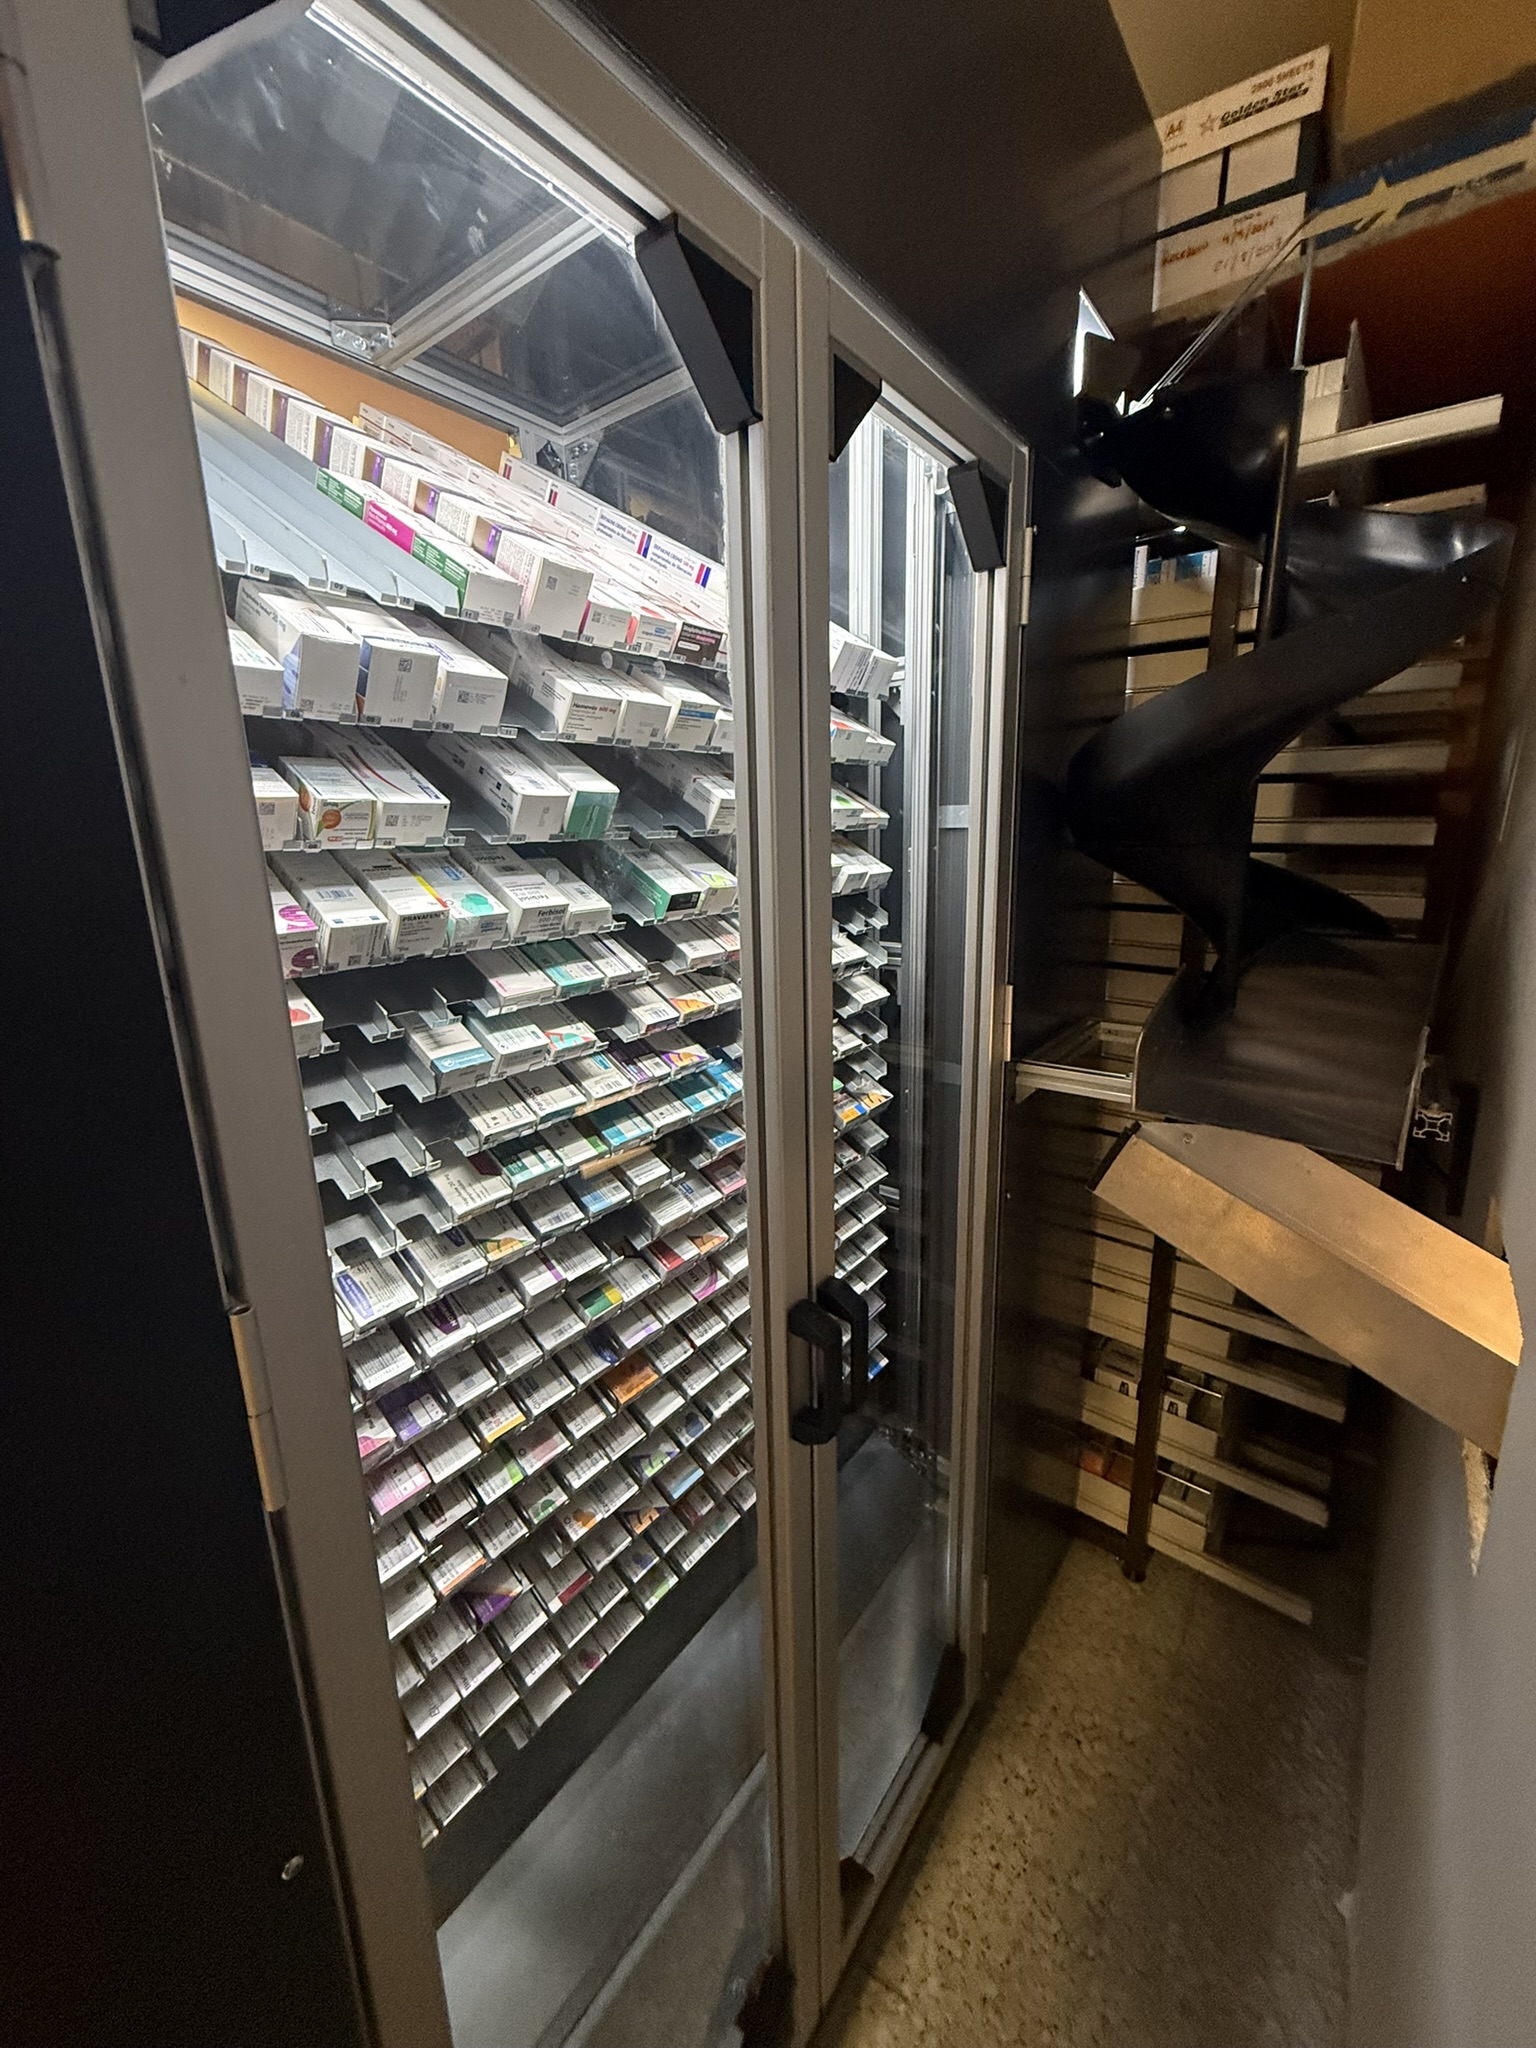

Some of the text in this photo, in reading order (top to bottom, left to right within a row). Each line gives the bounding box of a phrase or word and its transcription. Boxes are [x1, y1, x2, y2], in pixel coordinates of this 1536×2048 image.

[1277, 60, 1315, 82] SHEETS
[1220, 81, 1306, 120] Golden Star
[1165, 120, 1183, 138] A4
[518, 894, 550, 903] Ferbisol
[401, 912, 447, 923] PRAVAFENI
[537, 907, 566, 918] Ferbisol
